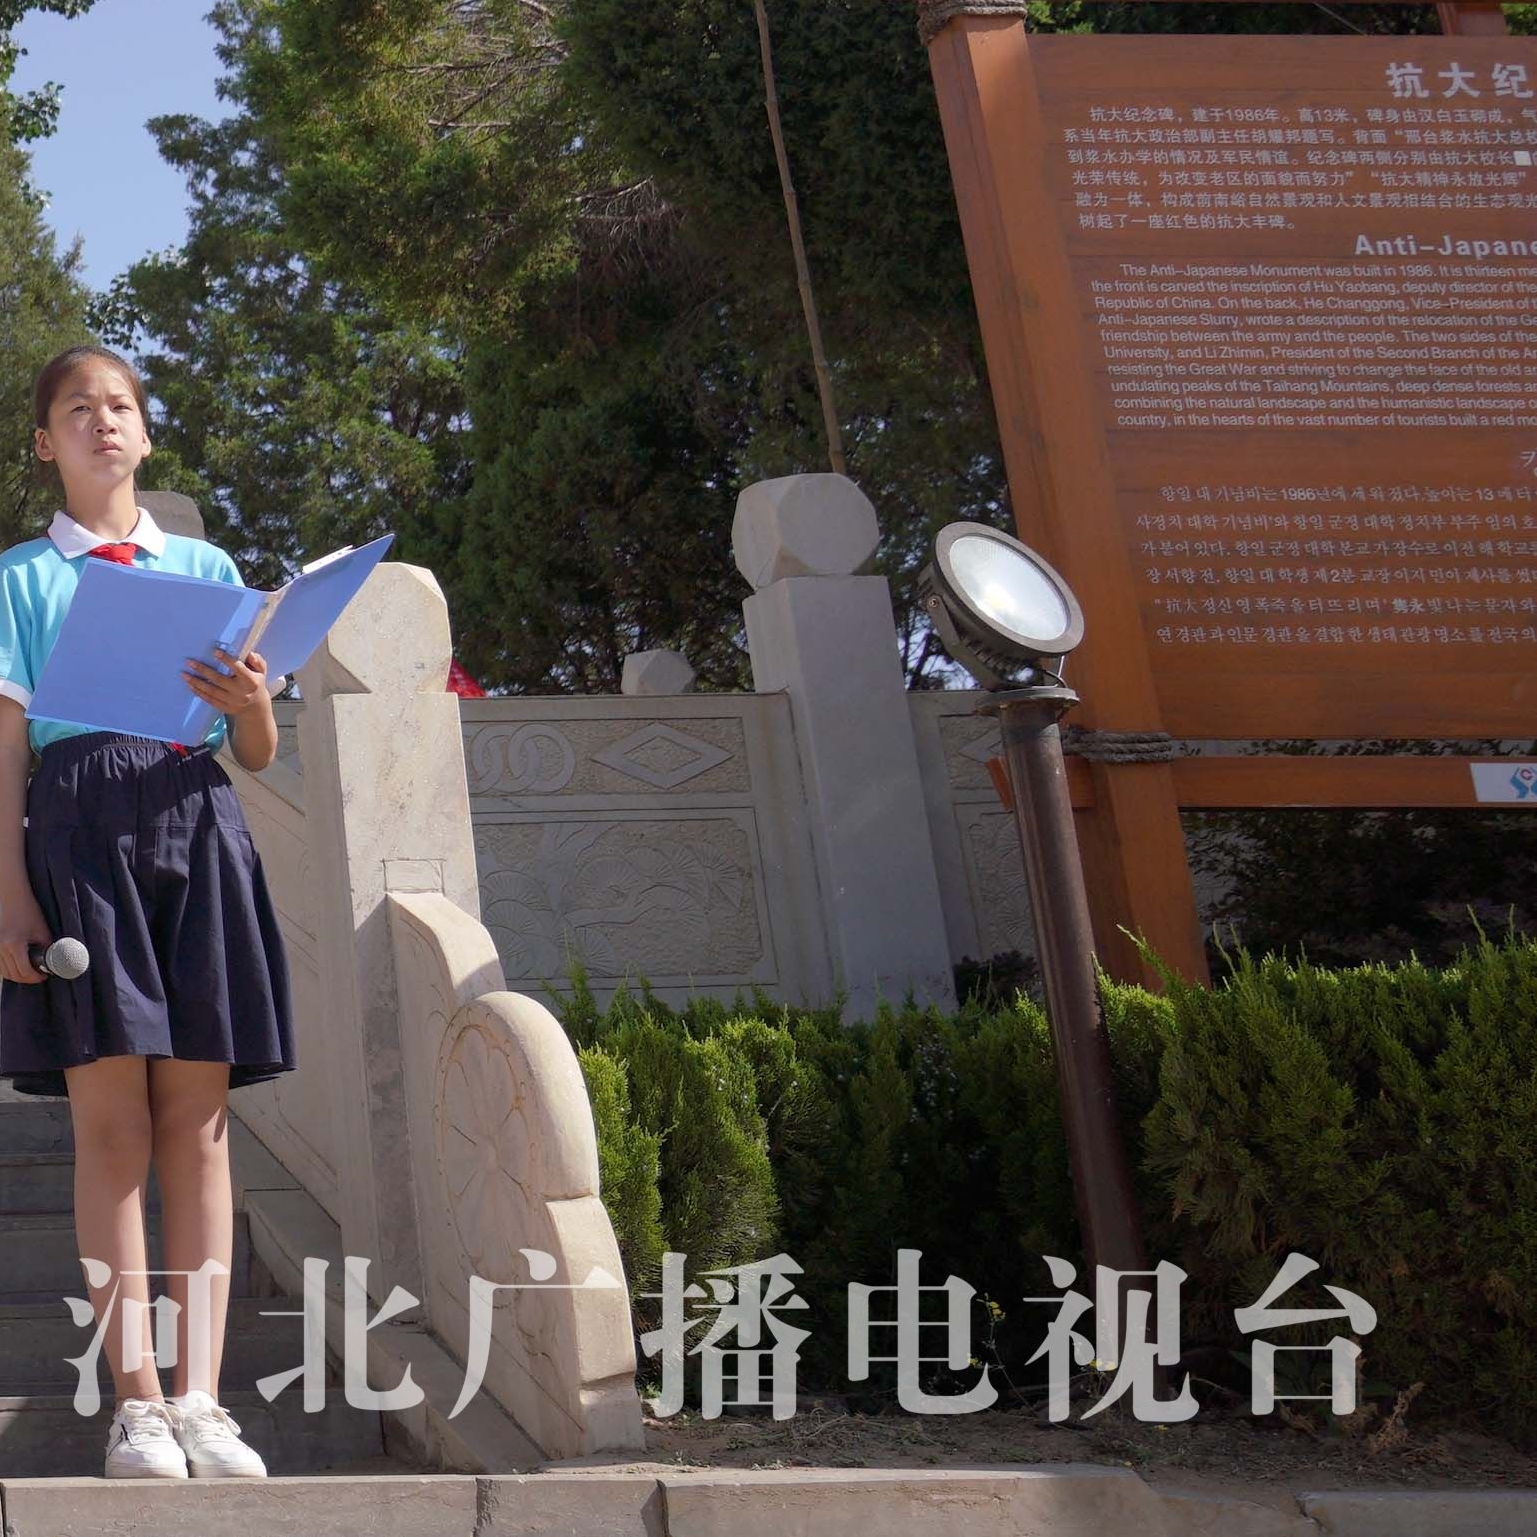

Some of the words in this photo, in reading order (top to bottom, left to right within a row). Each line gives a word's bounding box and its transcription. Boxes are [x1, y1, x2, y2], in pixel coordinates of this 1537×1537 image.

[1385, 62, 1534, 99] 抗大纪
[1119, 264, 1147, 276] The
[1249, 264, 1320, 276] Monument
[1323, 267, 1350, 276] was
[1352, 264, 1380, 276] built
[1383, 264, 1395, 276] in
[1438, 264, 1448, 276] It
[1451, 264, 1462, 276] is
[1464, 264, 1515, 276] thirteen
[1091, 280, 1112, 292] the
[1114, 280, 1144, 292] front
[1146, 280, 1158, 292] is
[1160, 280, 1204, 292] carved
[1206, 280, 1228, 292] the
[1230, 280, 1296, 295] inscription
[1298, 280, 1311, 292] of
[1313, 280, 1334, 292] Hu
[1401, 280, 1446, 295] deputy
[1448, 280, 1498, 292] director
[1500, 280, 1513, 292] of
[1516, 280, 1537, 292] the
[1095, 297, 1153, 311] Republic
[1155, 297, 1169, 309] of
[1217, 297, 1238, 309] On
[1240, 297, 1262, 309] the
[1303, 297, 1324, 309] He
[1515, 297, 1529, 309] of
[1244, 313, 1283, 325] wrote
[1285, 315, 1294, 325] a
[1296, 313, 1369, 327] description
[1371, 313, 1385, 325] of
[1387, 313, 1409, 325] the
[1411, 313, 1477, 325] relocation
[1479, 313, 1493, 325] of
[1495, 313, 1518, 325] the
[1101, 330, 1168, 345] friendship
[1170, 330, 1229, 342] between
[1231, 330, 1254, 342] the
[1257, 333, 1291, 345] army
[1293, 330, 1320, 342] and
[1323, 330, 1345, 342] the
[1402, 330, 1429, 342] The
[1431, 330, 1457, 342] two
[1459, 330, 1496, 342] sides
[1498, 330, 1512, 342] of
[1515, 330, 1537, 342] the
[1175, 346, 1202, 358] and
[1204, 346, 1217, 358] Li
[1270, 346, 1334, 358] President
[1336, 346, 1350, 358] of
[1353, 346, 1374, 358] the
[1376, 346, 1428, 358] Second
[1430, 346, 1479, 358] Branch
[1481, 346, 1495, 358] of
[1497, 346, 1520, 358] the
[1108, 363, 1162, 377] resisting
[1164, 363, 1186, 375] the
[1189, 363, 1226, 375] Great
[1228, 363, 1257, 375] War
[1259, 363, 1285, 375] and
[1287, 363, 1334, 377] striving
[1336, 363, 1350, 375] to
[1352, 363, 1402, 377] change
[1404, 363, 1426, 375] the
[1428, 363, 1458, 375] face
[1460, 363, 1473, 375] of
[1475, 363, 1498, 375] the
[1500, 363, 1521, 375] old
[1111, 380, 1179, 395] undulating
[1181, 380, 1222, 395] peaks
[1224, 380, 1237, 392] of
[1240, 380, 1263, 392] the
[1265, 380, 1318, 395] Taihang
[1396, 380, 1430, 395] deep
[1432, 380, 1473, 392] dense
[1475, 380, 1521, 392] forests
[1114, 397, 1182, 411] combining
[1184, 397, 1206, 409] the
[1208, 397, 1255, 409] natural
[1257, 397, 1326, 411] landscape
[1328, 397, 1355, 409] and
[1357, 397, 1379, 409] the
[1381, 397, 1454, 409] humanistic
[1456, 397, 1526, 411] landscape
[1173, 414, 1185, 426] in
[1187, 414, 1209, 426] the
[1211, 414, 1255, 426] hearts
[1257, 414, 1270, 426] of
[1272, 414, 1294, 426] the
[1297, 414, 1325, 426] vast
[1327, 414, 1379, 426] number
[1382, 414, 1395, 426] of
[1397, 414, 1446, 426] tourists
[1448, 414, 1477, 426] built
[1479, 417, 1489, 426] a
[1491, 414, 1514, 426] red
